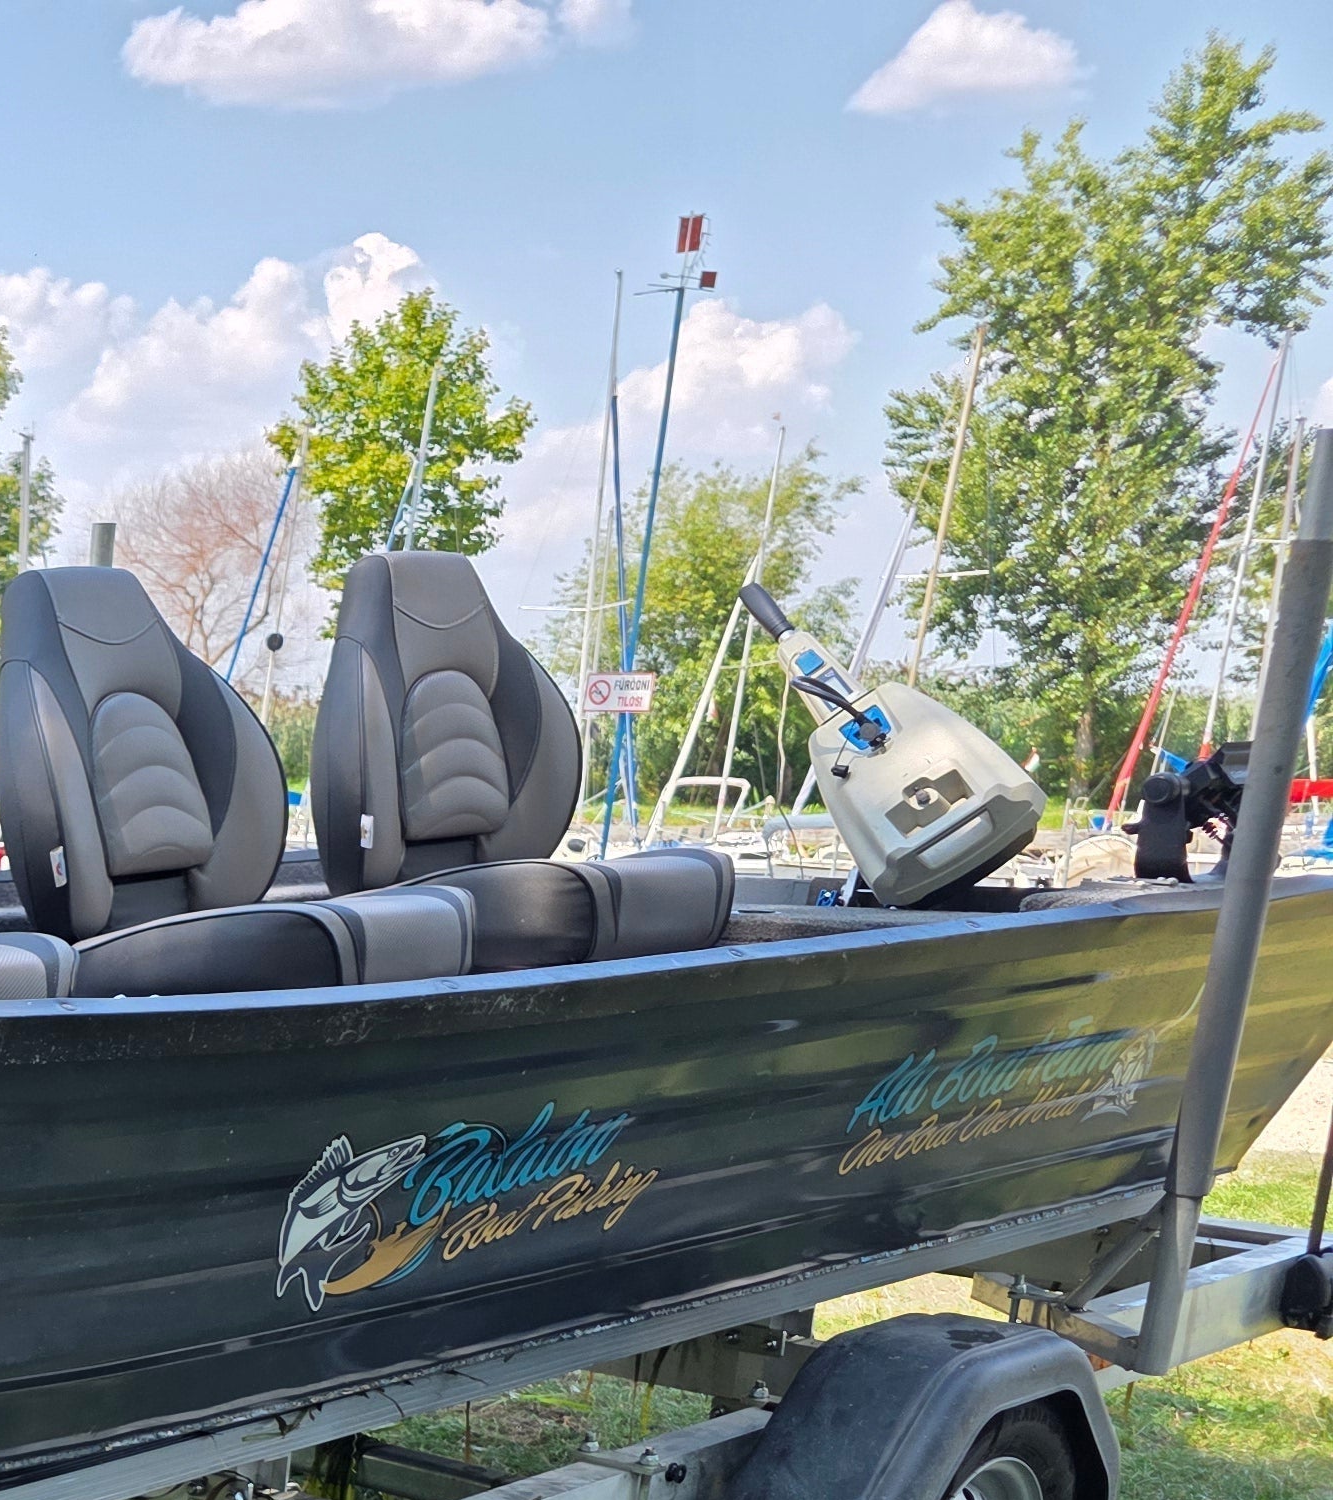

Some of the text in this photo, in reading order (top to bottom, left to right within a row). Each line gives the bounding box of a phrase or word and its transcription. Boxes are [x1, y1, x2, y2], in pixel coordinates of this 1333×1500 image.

[846, 1048, 940, 1133] Alu
[931, 1028, 1054, 1110] Boat
[403, 1101, 628, 1226] Balaton
[838, 1128, 903, 1175] One
[894, 1106, 977, 1160] Boat
[441, 1160, 659, 1261] Boat Fishing
